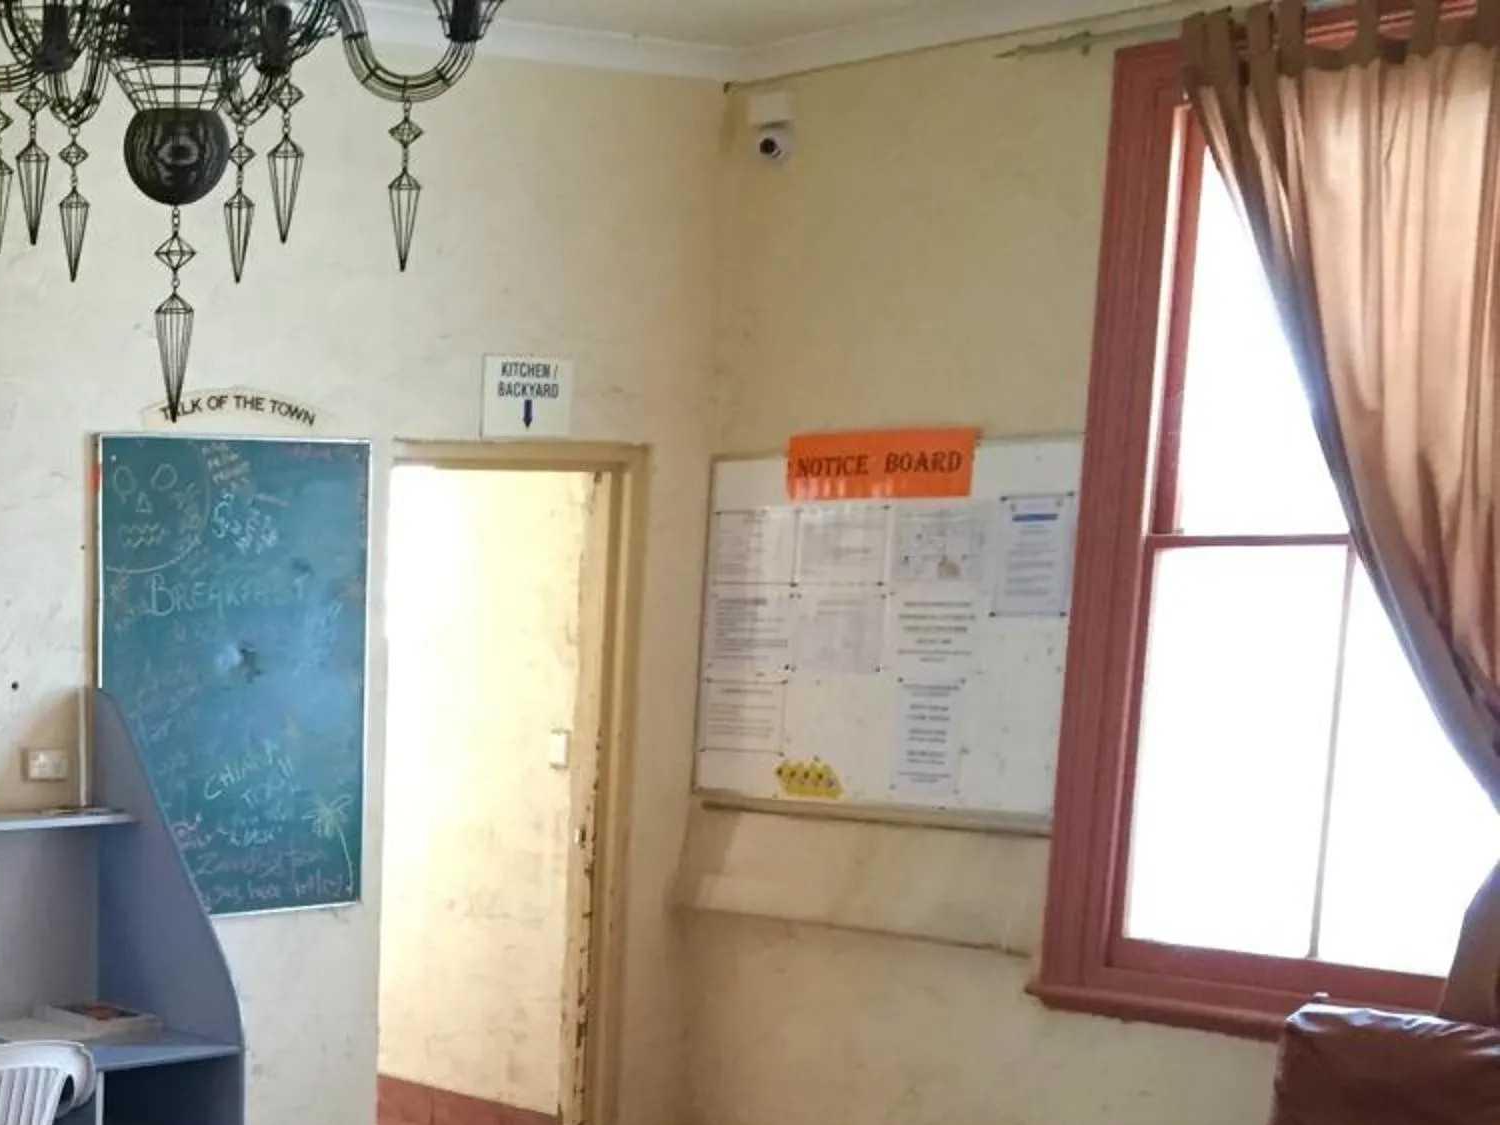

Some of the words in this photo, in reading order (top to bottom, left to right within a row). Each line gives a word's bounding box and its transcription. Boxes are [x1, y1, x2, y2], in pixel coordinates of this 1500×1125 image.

[501, 361, 550, 378] KITCHEN
[498, 381, 559, 399] BACKYARD
[206, 395, 228, 411] OF
[233, 395, 265, 412] THE
[269, 399, 317, 427] TOWN
[795, 454, 869, 478] NOTICE
[884, 450, 963, 474] BOARD
